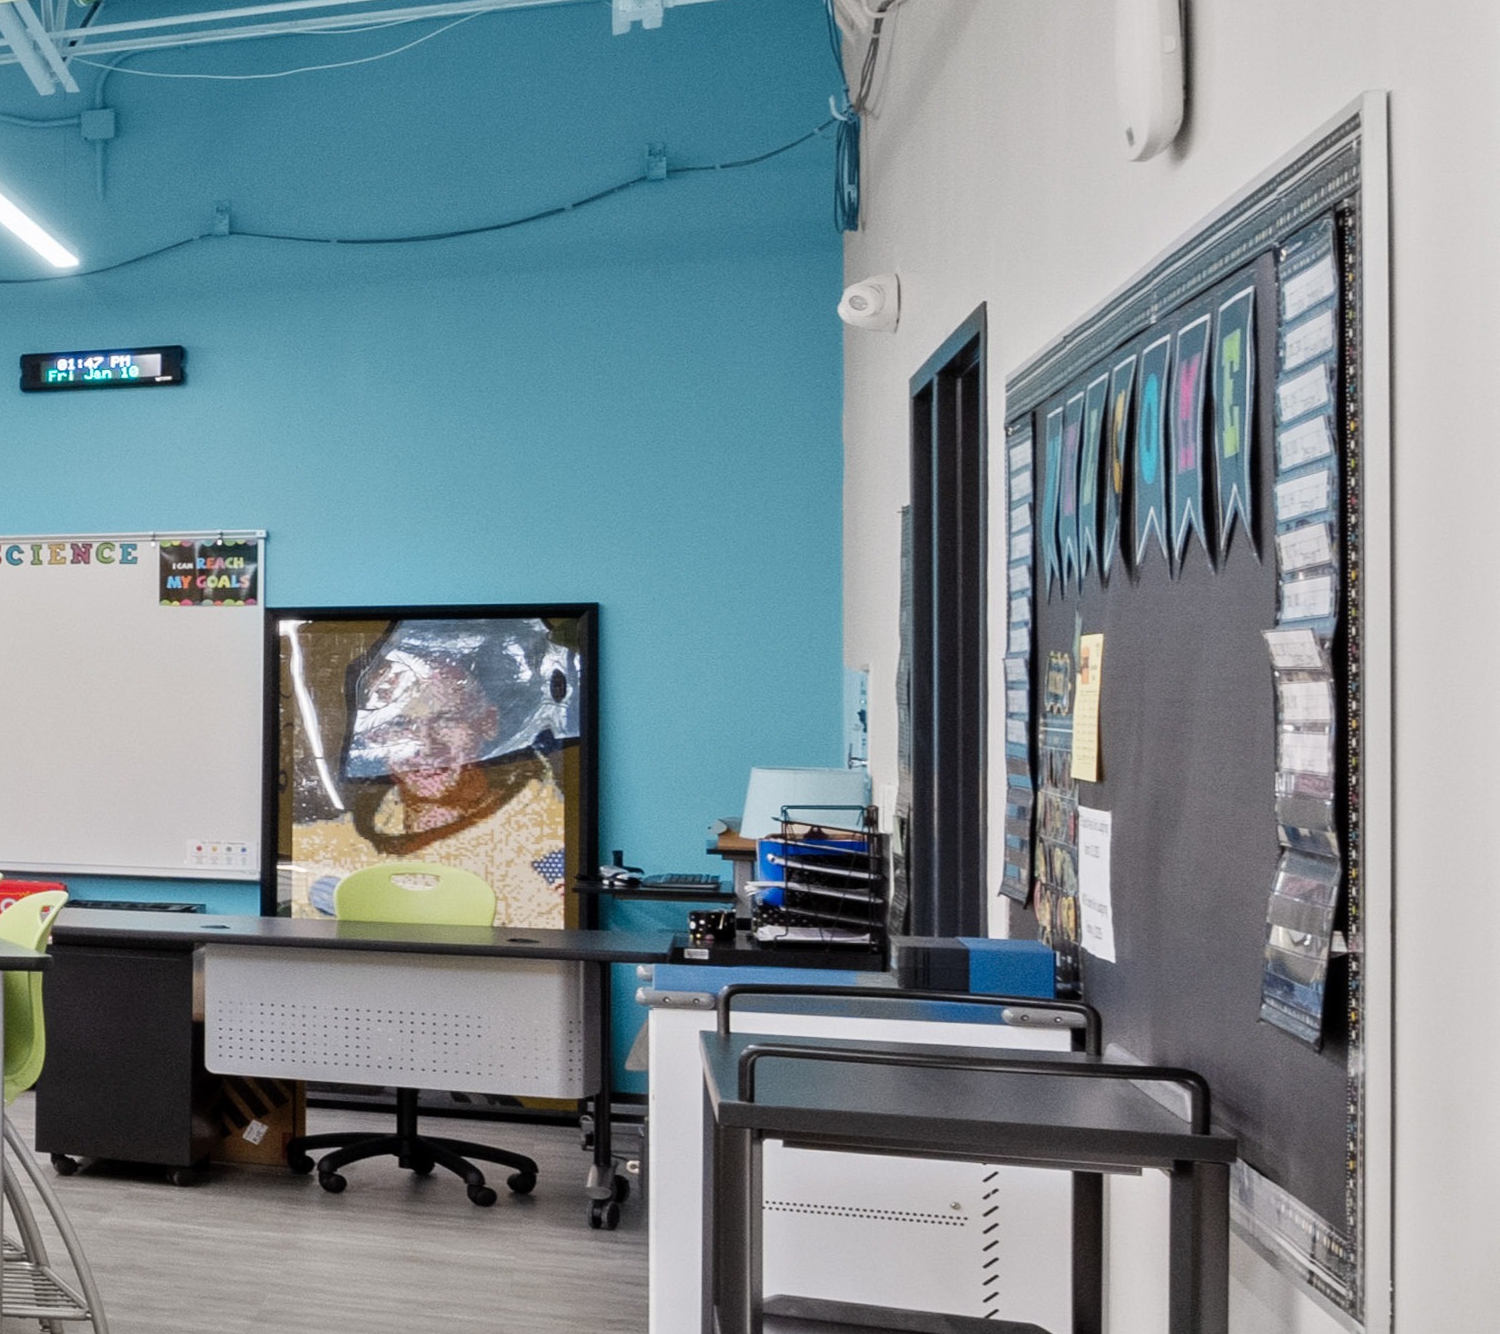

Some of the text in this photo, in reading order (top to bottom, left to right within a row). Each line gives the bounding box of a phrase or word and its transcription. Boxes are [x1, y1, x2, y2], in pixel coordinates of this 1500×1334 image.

[57, 355, 131, 371] 01:47 PM
[48, 366, 139, 382] Fri Jan 10
[196, 557, 244, 569] REACH
[167, 575, 250, 589] MY GOALS
